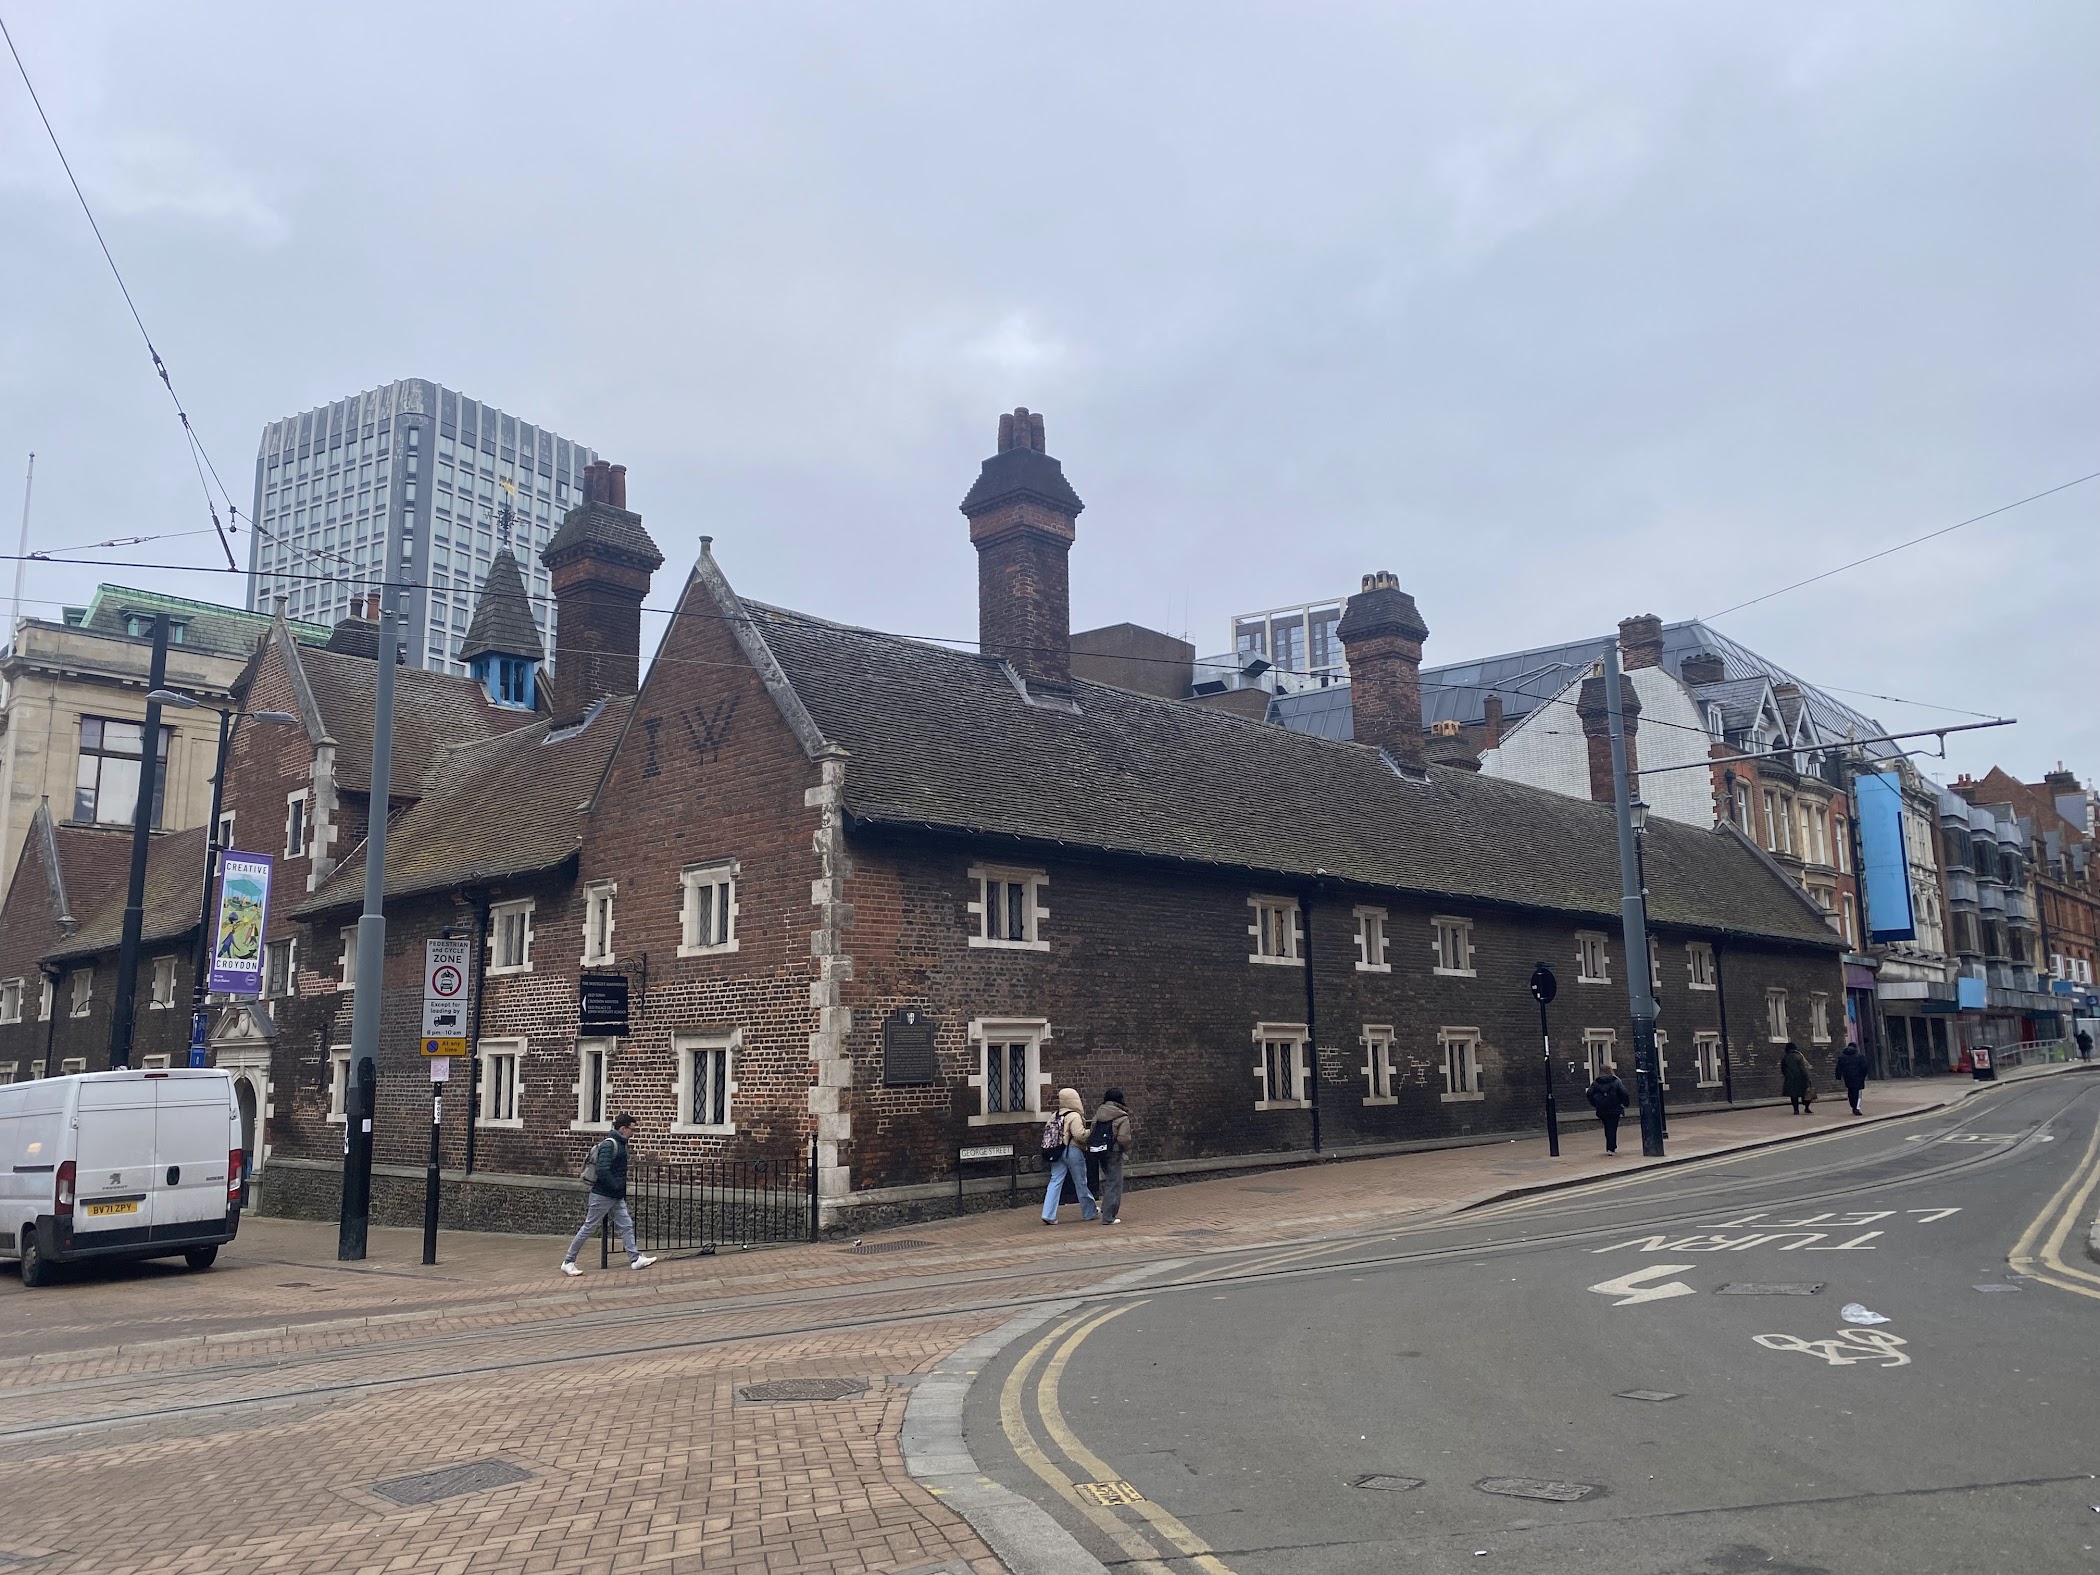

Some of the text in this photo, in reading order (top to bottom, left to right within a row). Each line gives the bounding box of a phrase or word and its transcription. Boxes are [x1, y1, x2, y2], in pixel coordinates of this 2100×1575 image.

[226, 862, 267, 875] CREATIVE
[428, 940, 469, 948] PEDESTRIAN
[433, 954, 462, 963] ZONE
[216, 960, 258, 970] CROYDON
[961, 1147, 1010, 1157] GEORGE STREET
[93, 1203, 132, 1215] BV71 ZPY
[1696, 1208, 1963, 1228] LEFT
[1591, 1231, 1885, 1253] TURN
